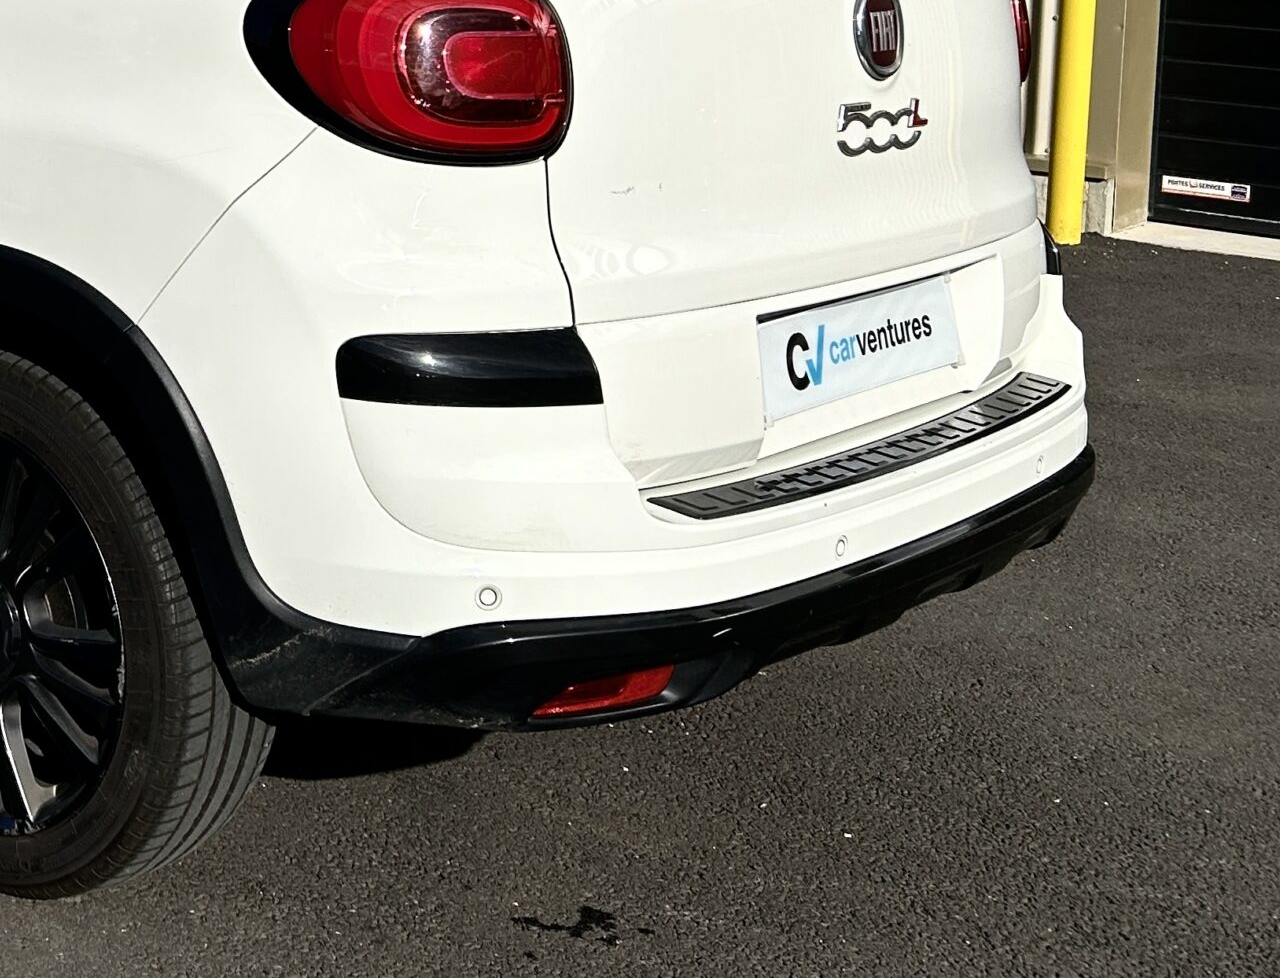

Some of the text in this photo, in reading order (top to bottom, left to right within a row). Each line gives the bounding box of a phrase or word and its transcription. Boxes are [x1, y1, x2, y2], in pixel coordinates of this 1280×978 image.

[869, 9, 896, 53] FIAT
[1198, 182, 1225, 191] SERVICES
[829, 314, 932, 365] carventures
